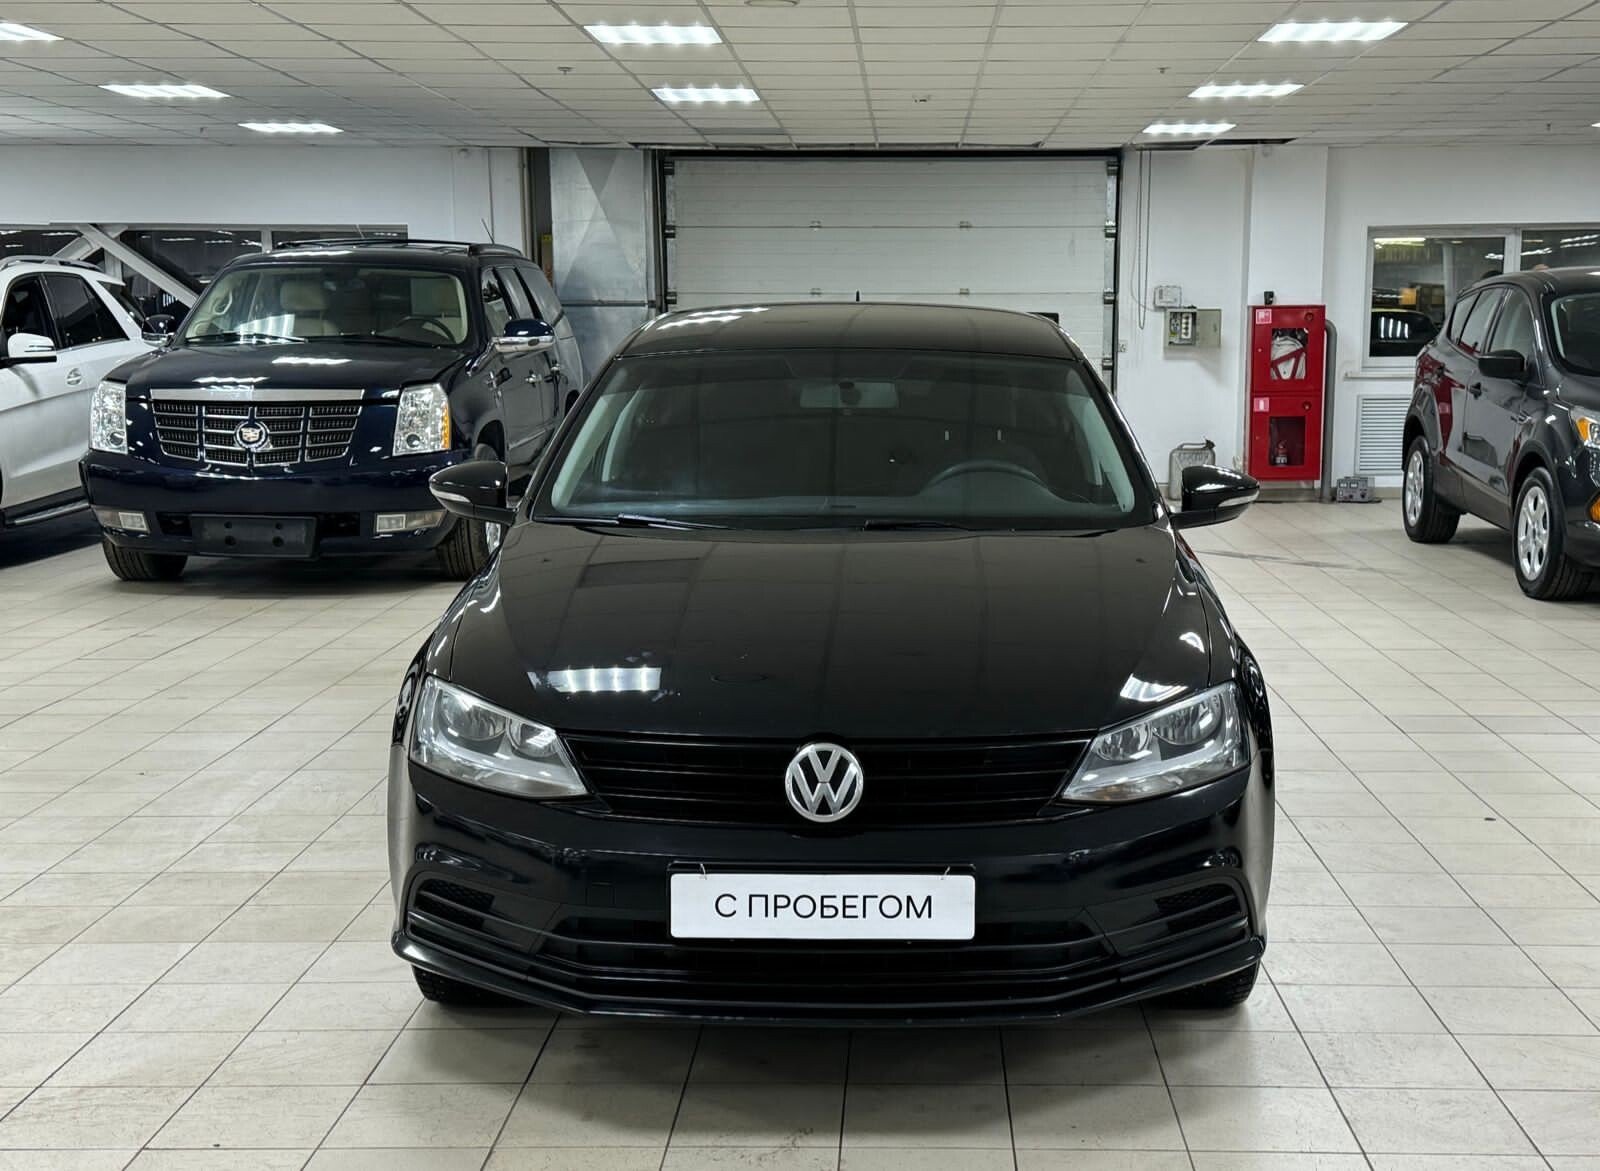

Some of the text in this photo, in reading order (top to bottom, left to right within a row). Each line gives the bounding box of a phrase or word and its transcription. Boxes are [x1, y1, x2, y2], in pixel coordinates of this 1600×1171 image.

[786, 743, 863, 822] VW
[714, 893, 932, 919] С ПРОБЕГОМ
